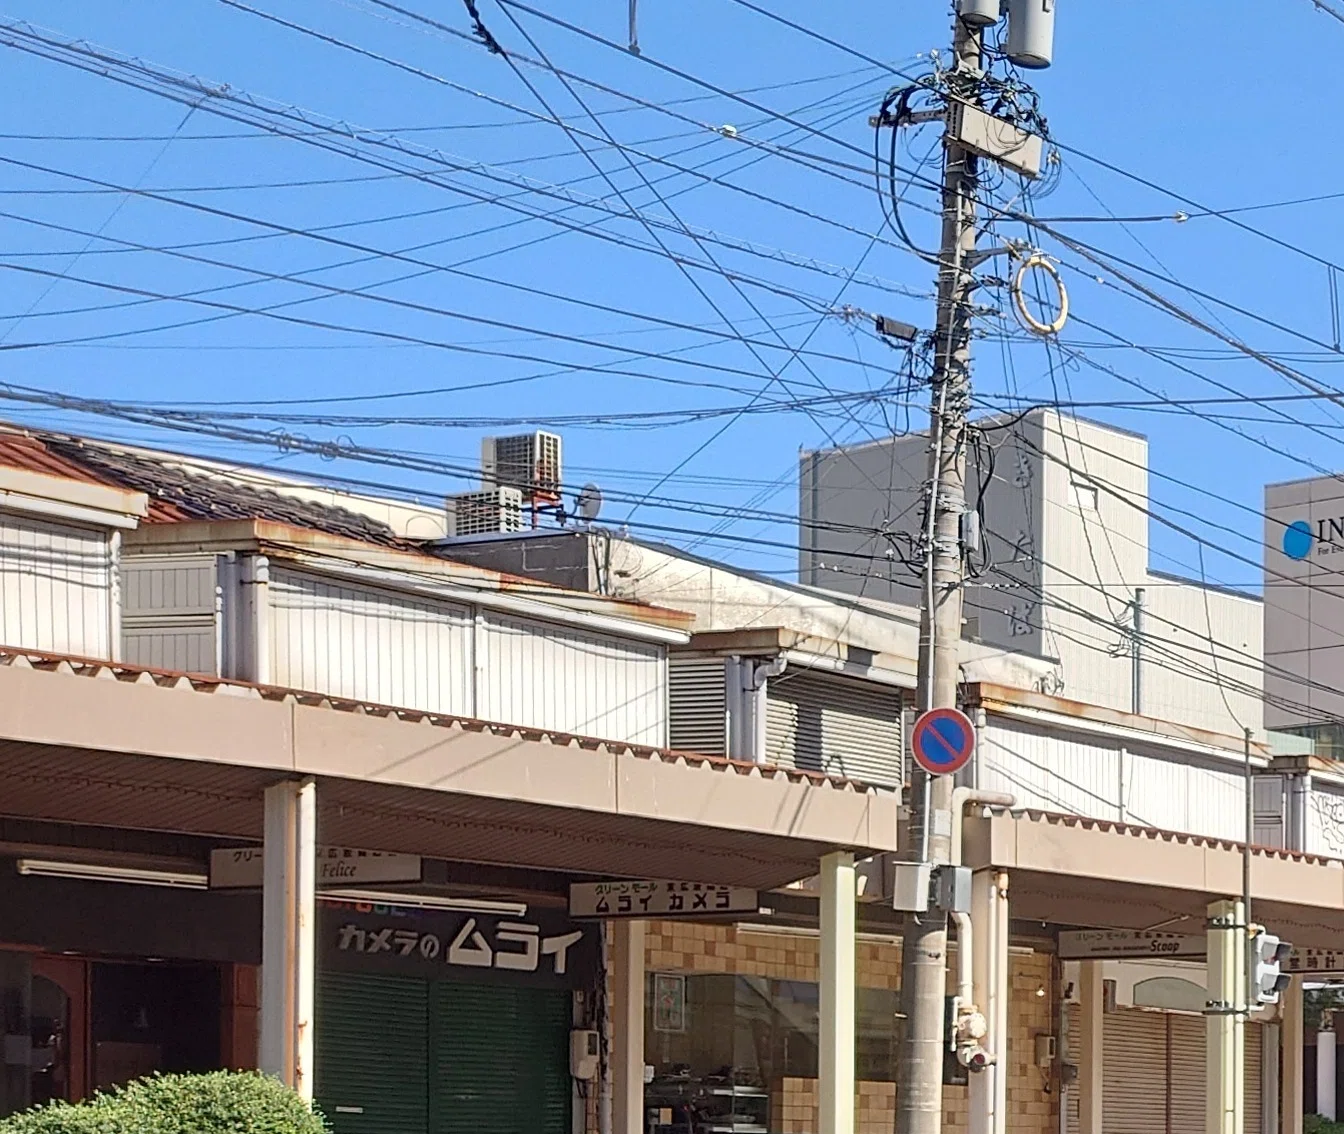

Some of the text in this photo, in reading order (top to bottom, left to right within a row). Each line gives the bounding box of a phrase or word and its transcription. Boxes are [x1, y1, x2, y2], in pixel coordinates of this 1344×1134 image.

[322, 862, 357, 878] Felice
[596, 891, 731, 913] ムライ カメラ
[339, 918, 584, 974] カメラのムライ
[1150, 940, 1180, 953] Scoop
